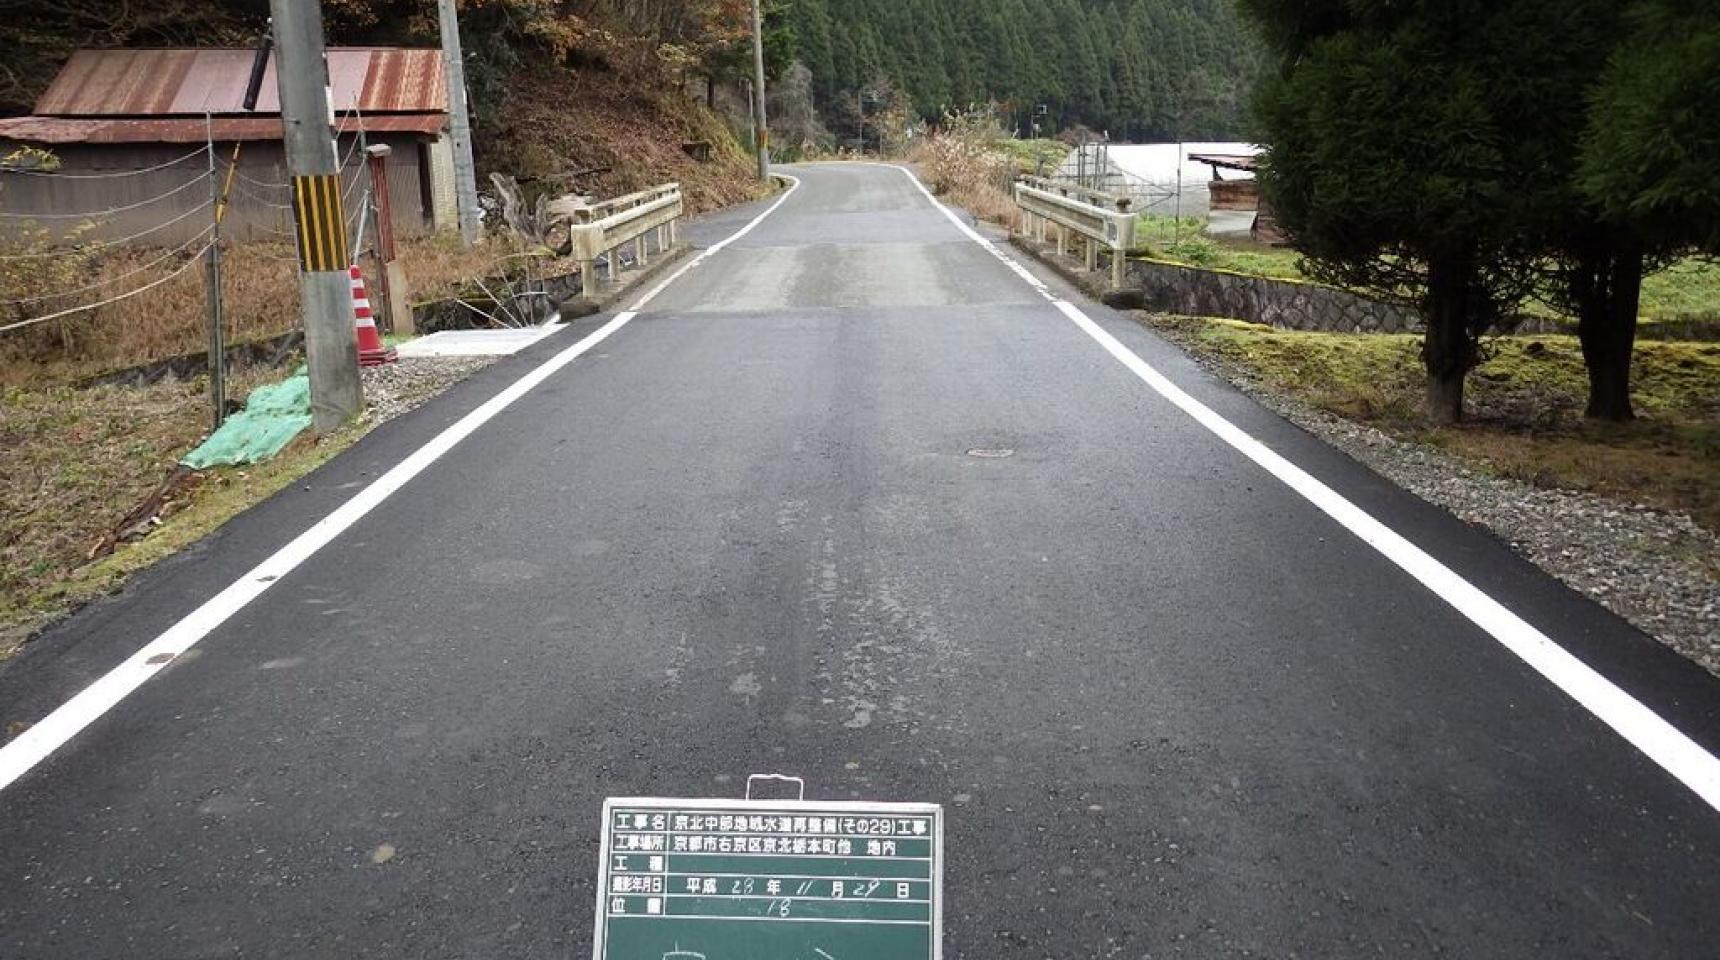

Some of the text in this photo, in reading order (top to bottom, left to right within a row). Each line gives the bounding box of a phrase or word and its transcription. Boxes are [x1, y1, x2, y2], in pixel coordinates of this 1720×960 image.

[616, 813, 665, 830] 工事名
[867, 839, 896, 856] 地内
[686, 877, 717, 895] 平成
[767, 878, 781, 895] 年
[831, 880, 844, 898] 月
[896, 881, 910, 898] 日
